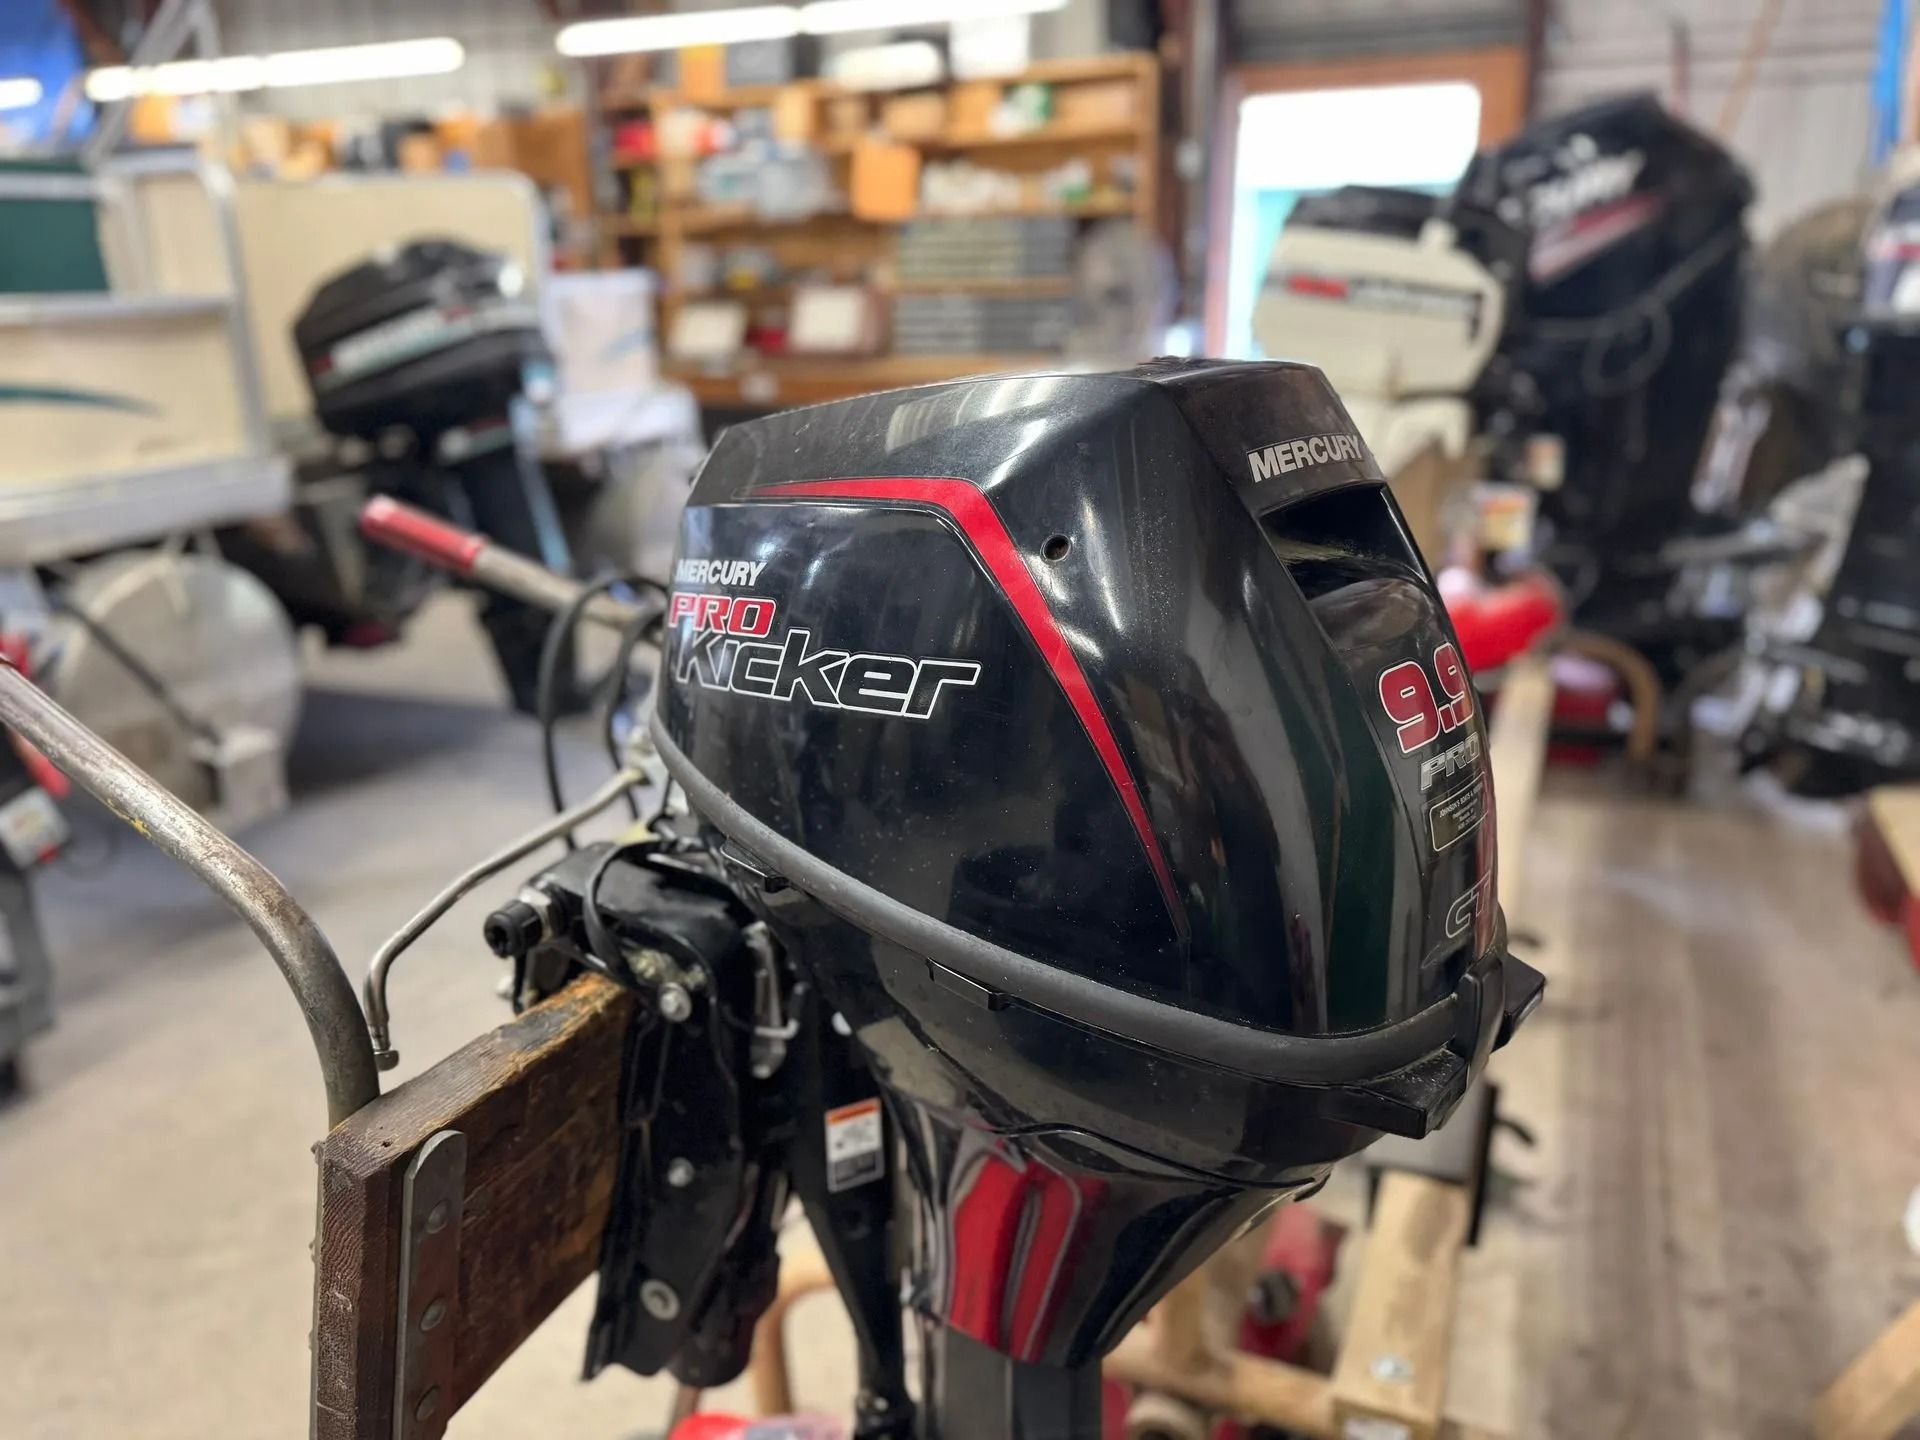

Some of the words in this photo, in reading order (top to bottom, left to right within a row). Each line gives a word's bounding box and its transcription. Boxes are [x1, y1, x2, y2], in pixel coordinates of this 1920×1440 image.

[1248, 434, 1363, 483] MERCURY
[675, 558, 767, 587] MERCURY
[668, 591, 777, 639] PRO
[675, 628, 982, 719] Kicker
[1378, 641, 1475, 754] 9.9
[1420, 731, 1481, 791] PRO
